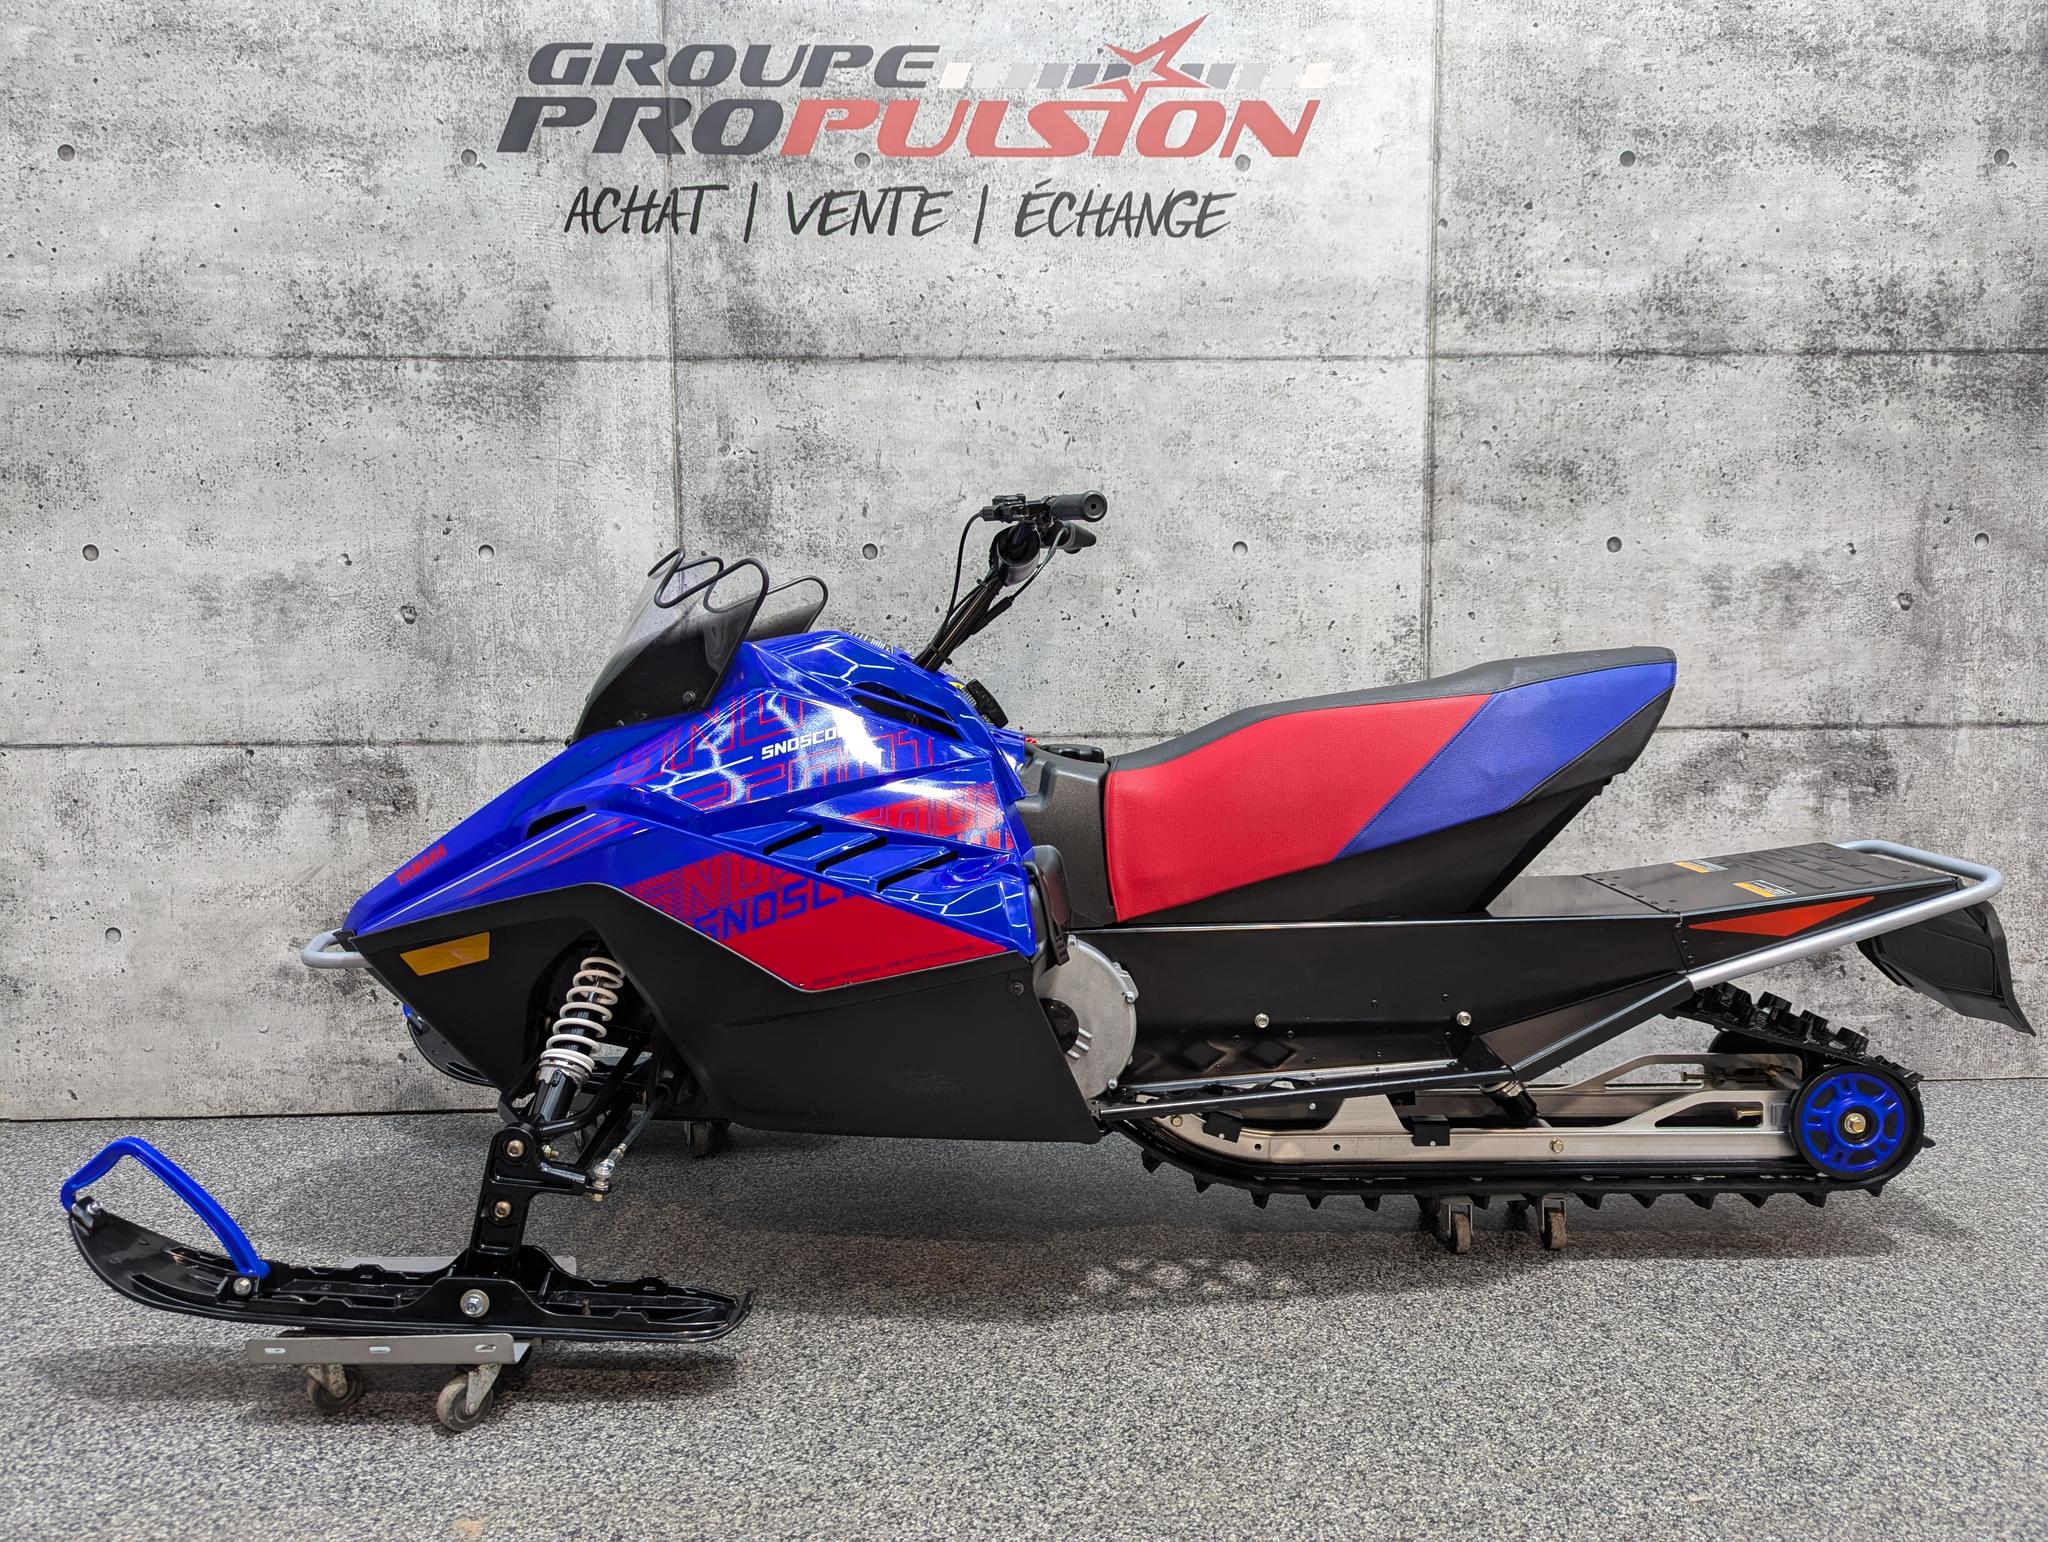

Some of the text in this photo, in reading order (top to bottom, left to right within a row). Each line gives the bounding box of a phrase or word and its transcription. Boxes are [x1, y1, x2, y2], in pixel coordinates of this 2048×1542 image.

[528, 42, 940, 88] GROUPE
[497, 96, 1322, 158] PROPULSION
[563, 185, 730, 236] ACHAT
[786, 184, 954, 238] VENTE
[1014, 178, 1237, 238] ÉCHANGE
[761, 725, 842, 760] SNOSCO
